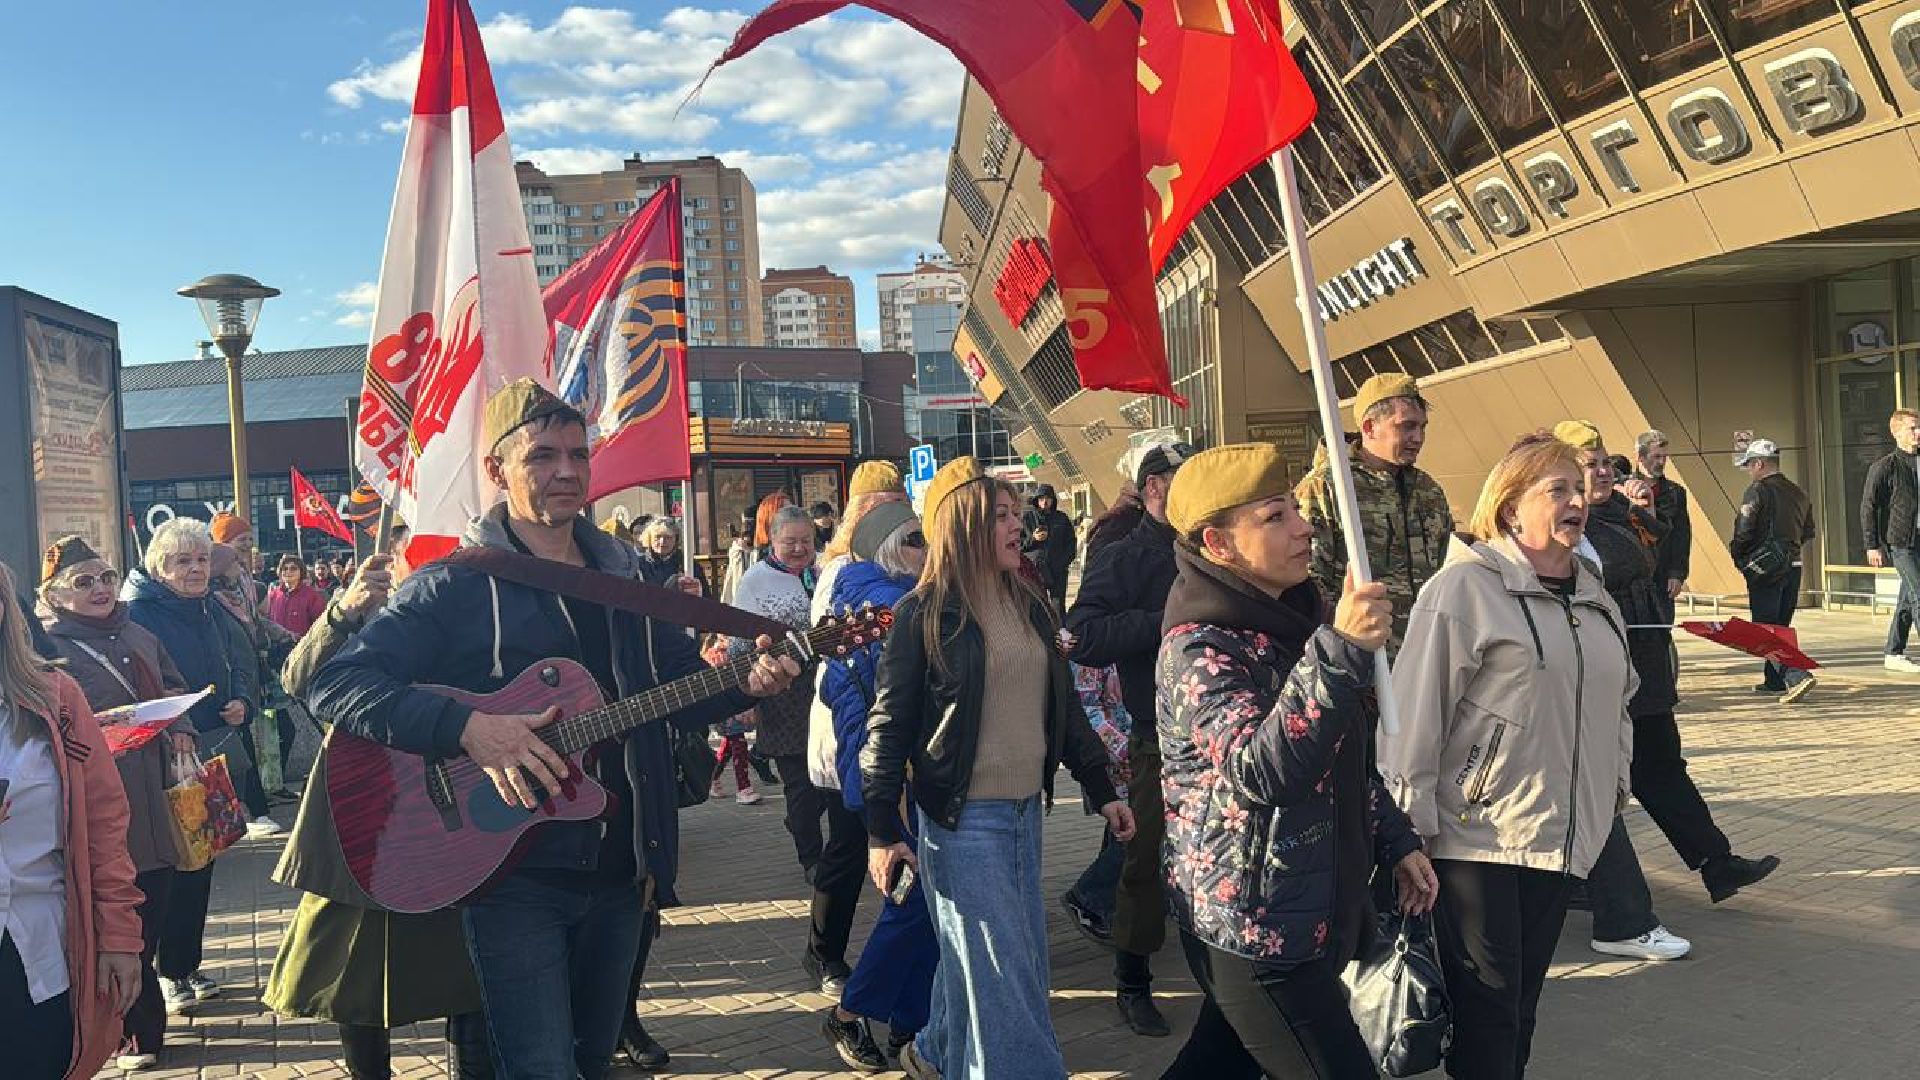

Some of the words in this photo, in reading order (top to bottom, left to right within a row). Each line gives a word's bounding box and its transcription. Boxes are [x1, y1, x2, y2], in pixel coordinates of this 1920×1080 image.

[1296, 236, 1423, 324] NLIGHT
[1062, 287, 1109, 349] 5
[916, 449, 930, 479] P
